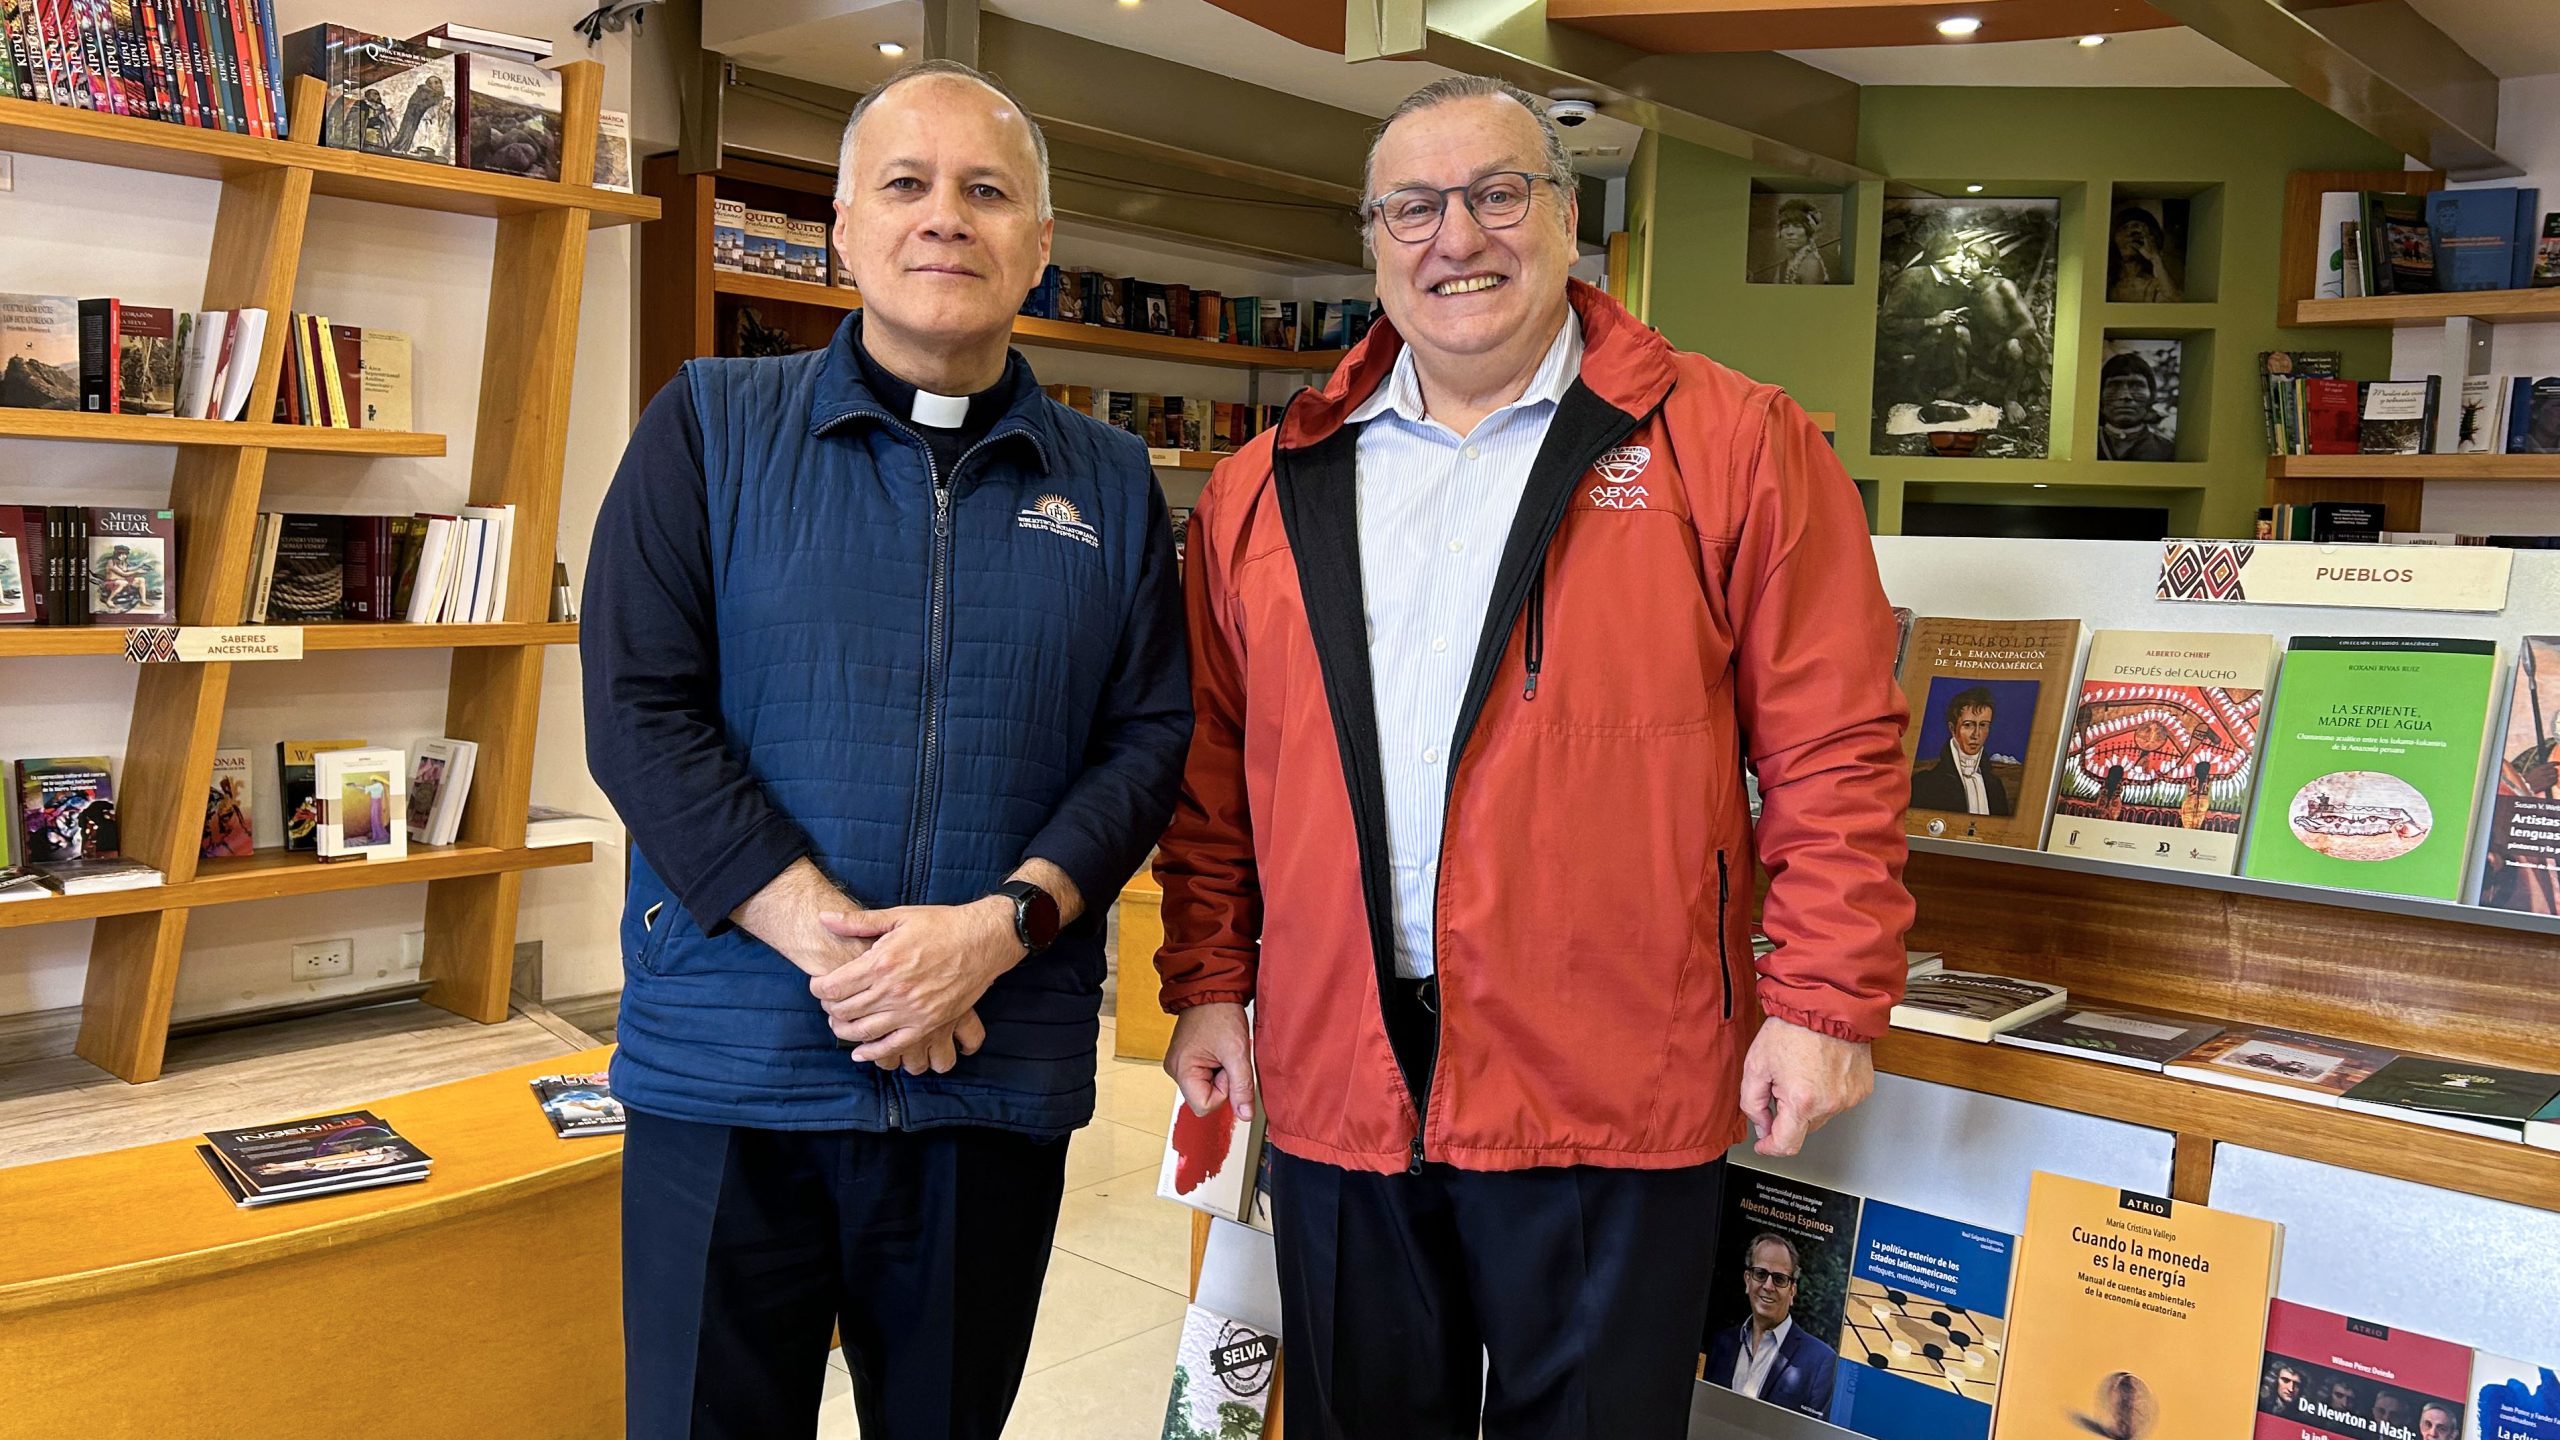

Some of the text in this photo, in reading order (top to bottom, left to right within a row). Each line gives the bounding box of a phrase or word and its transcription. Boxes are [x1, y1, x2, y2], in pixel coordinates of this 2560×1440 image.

[13, 33, 27, 67] KIPU
[27, 33, 44, 68] KIPU
[48, 37, 64, 71] KIPU
[69, 41, 84, 74] KIPU
[84, 32, 102, 76] KIPU 67
[104, 33, 121, 78] KIPU 67
[121, 41, 132, 66] KIPU
[131, 43, 141, 68] KIPU
[140, 42, 151, 67] KIPU
[164, 45, 174, 70] KIPU
[182, 52, 193, 75] KIPU
[194, 51, 203, 73] KIPU
[218, 60, 228, 82] KIPU
[230, 63, 239, 84] KIPU
[492, 70, 541, 88] FLOREANA
[745, 212, 785, 225] QUITO
[786, 222, 824, 234] QUITO
[1589, 485, 1649, 498] ABYA
[1589, 494, 1647, 509] YALA
[2316, 567, 2414, 583] PUEBLOS
[208, 645, 279, 654] ANCESTRALES
[221, 635, 266, 643] SABERES
[1940, 634, 2049, 648] HUMBOLDT
[1937, 647, 2047, 659] Y LA EMANCIPACIÓN
[2146, 650, 2211, 659] ALBERTO CHIRIF
[1934, 659, 2044, 670] DE HISPANOAMÉRICA
[2113, 665, 2237, 680] DESPUÉS del CAUCHO
[2332, 704, 2348, 714] LA
[2318, 716, 2433, 731] MADRE DEL AGUA
[2379, 736, 2389, 744] los
[2514, 801, 2537, 809] Susan
[2512, 813, 2560, 827] Artistas
[1921, 975, 2047, 997] AUTONOMÍAS
[1740, 1198, 1769, 1215] Alberto
[1769, 1206, 1796, 1223] Acosta
[1797, 1213, 1834, 1234] Espinosa
[1811, 1206, 1817, 1214] de
[2127, 1198, 2164, 1214] ATRIO
[2106, 1217, 2177, 1242] María Cristina Vallejo
[1872, 1239, 1960, 1271] La política exterior de los
[2072, 1226, 2210, 1273] Cuando la moneda
[1870, 1251, 1958, 1284] Estados latinoamericanos:
[2093, 1254, 2186, 1288] es la energía
[1868, 1264, 1957, 1296] enfoques, metodologías y casos
[2078, 1271, 2196, 1309] Manual de cuentas ambientales
[2084, 1286, 2187, 1320] de la economía ecuatoriana
[2352, 1323, 2383, 1337] ATRIO
[1222, 1342, 1268, 1366] SELVA
[2331, 1356, 2353, 1368] Wilson
[1235, 1381, 1256, 1392] papel
[2298, 1397, 2417, 1440] De Newton a Nash:
[2498, 1426, 2510, 1440] La
